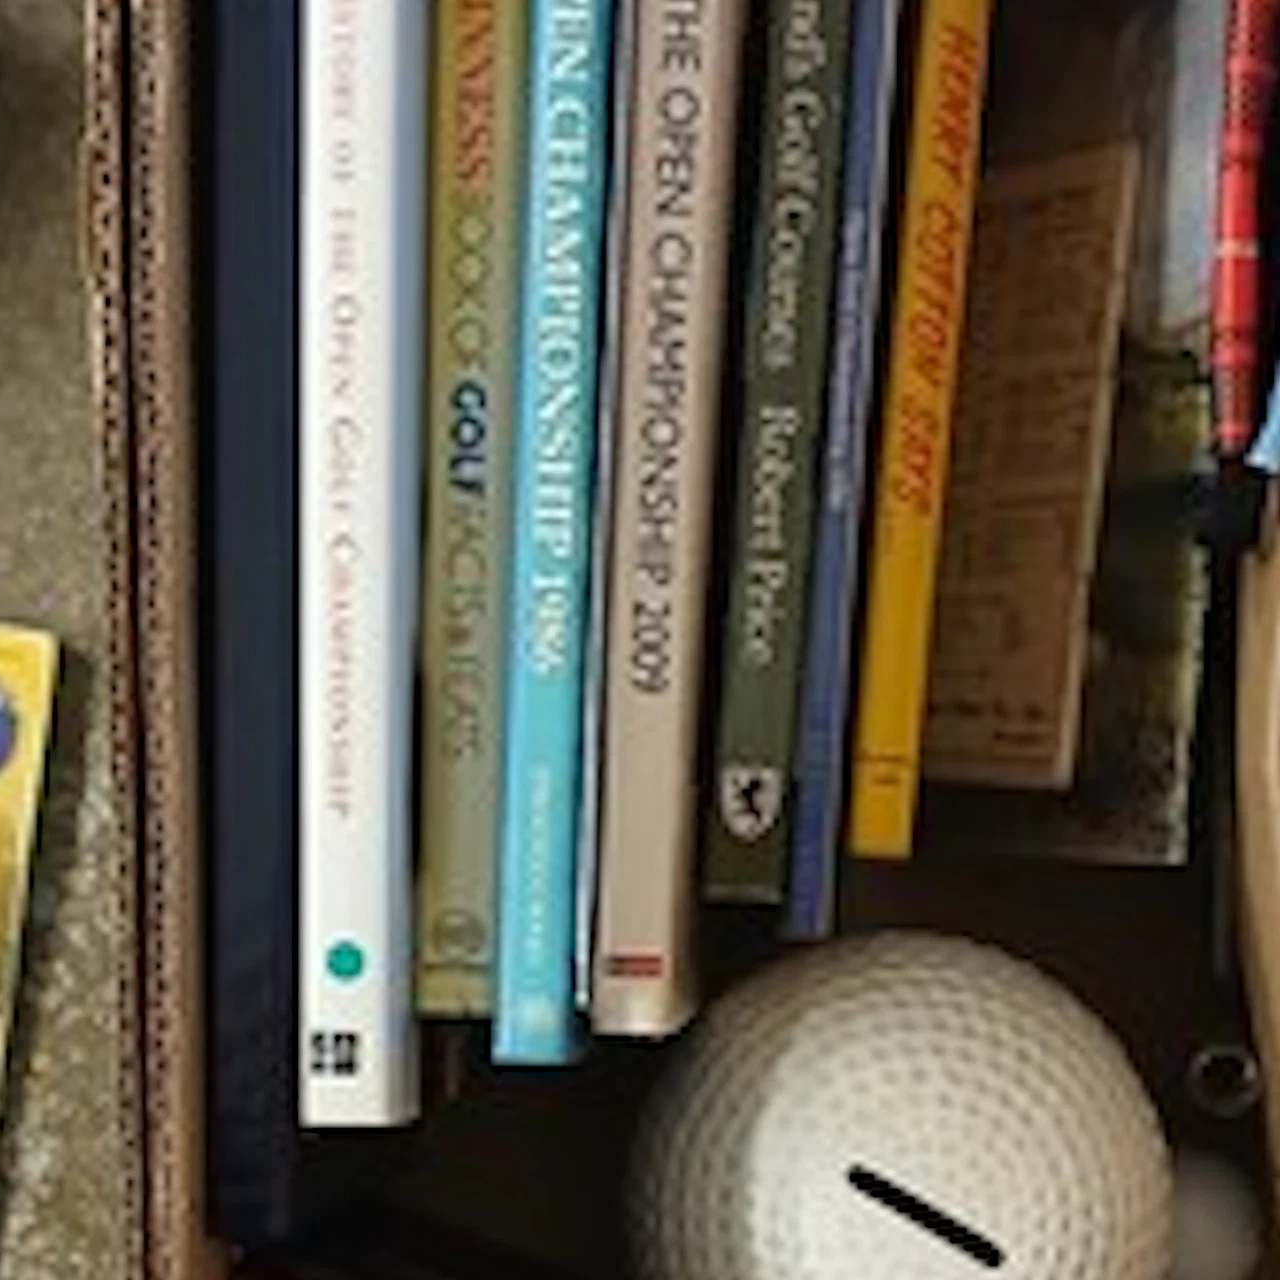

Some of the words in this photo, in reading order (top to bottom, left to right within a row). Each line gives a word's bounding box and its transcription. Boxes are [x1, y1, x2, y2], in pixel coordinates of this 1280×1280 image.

[655, 86, 700, 215] OPEN
[778, 89, 824, 189] Golf
[930, 22, 979, 186] HENRY
[532, 101, 598, 560] CHAMPIONSHIP
[761, 196, 816, 372] Courses
[908, 199, 966, 386] COTTON
[446, 381, 488, 499] GOLF
[636, 231, 696, 587] CHAMPIONSHIP
[895, 395, 939, 517] SAYS
[754, 406, 798, 551] Robert
[531, 571, 570, 675] 1986
[631, 601, 672, 695] 2009
[744, 559, 790, 669] Price
